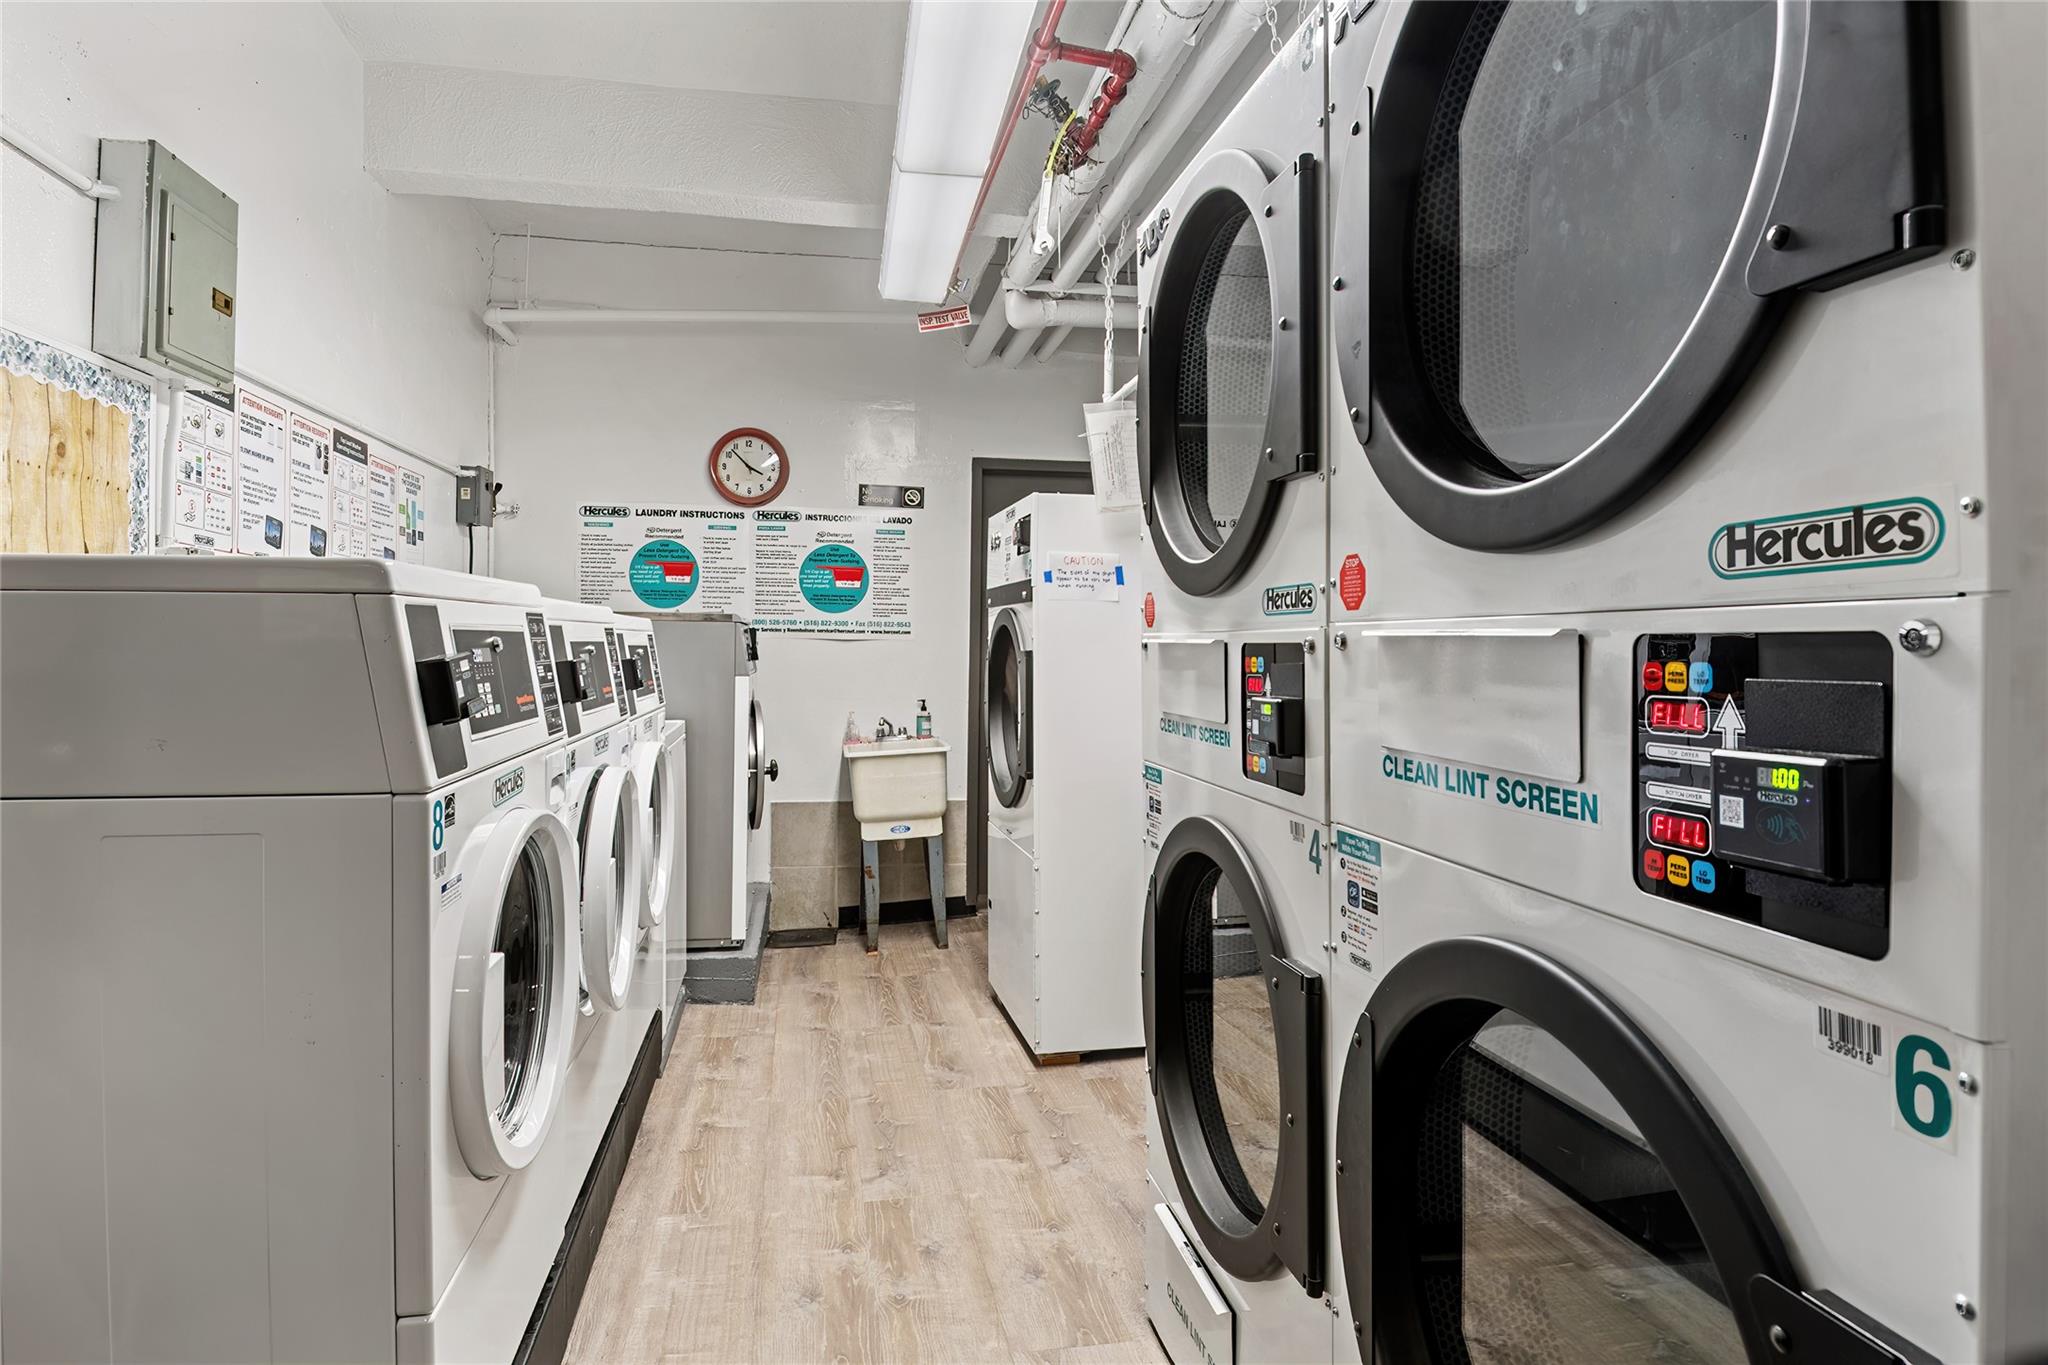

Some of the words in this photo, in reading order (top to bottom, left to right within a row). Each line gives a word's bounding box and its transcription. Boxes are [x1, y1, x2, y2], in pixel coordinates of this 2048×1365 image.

[919, 317, 934, 326] INSP.
[934, 314, 949, 325] TEST
[951, 311, 968, 321] VALVE
[745, 440, 753, 448] 12
[725, 451, 733, 459] 10
[721, 462, 727, 470] 9
[770, 464, 776, 472] 3
[725, 473, 731, 482] 8
[177, 485, 182, 496] 5
[735, 483, 739, 491] 7
[747, 487, 752, 495] 6
[759, 483, 765, 492] 5
[862, 487, 872, 495] No
[206, 493, 212, 504] 6
[862, 495, 894, 505] Smoking
[584, 507, 627, 517] Hercules
[635, 509, 677, 518] LAUNDRY
[680, 510, 745, 519] INSTRUCTIONS
[757, 511, 799, 520] Hercules
[1726, 507, 1924, 567] Hercules
[1063, 556, 1104, 566] CAUTION
[1345, 558, 1360, 569] STOP
[1266, 584, 1313, 610] Hercules
[1653, 703, 1703, 728] FILL
[1160, 717, 1181, 736] CLEAN
[1182, 722, 1197, 739] LINT
[1199, 725, 1231, 748] SCREEN
[1681, 751, 1699, 759] DRYER
[495, 771, 523, 801] Hercules
[1382, 754, 1438, 788] CLEAN
[1445, 766, 1489, 799] LINT
[1496, 776, 1598, 824] SCREEN
[1665, 789, 1685, 798] BOTTOM
[1685, 792, 1703, 800] DRYER
[433, 800, 444, 851] 8
[1653, 815, 1705, 846] FILL
[1309, 829, 1322, 875] 4
[1670, 863, 1687, 872] PERM
[1699, 869, 1708, 877] LO
[1669, 870, 1688, 879] PRESS
[1696, 876, 1712, 885] TEMP
[1828, 1038, 1874, 1065] 399018
[1896, 1034, 1952, 1138] 6
[1167, 1282, 1189, 1330] CLEAN
[1190, 1321, 1207, 1358] LINT
